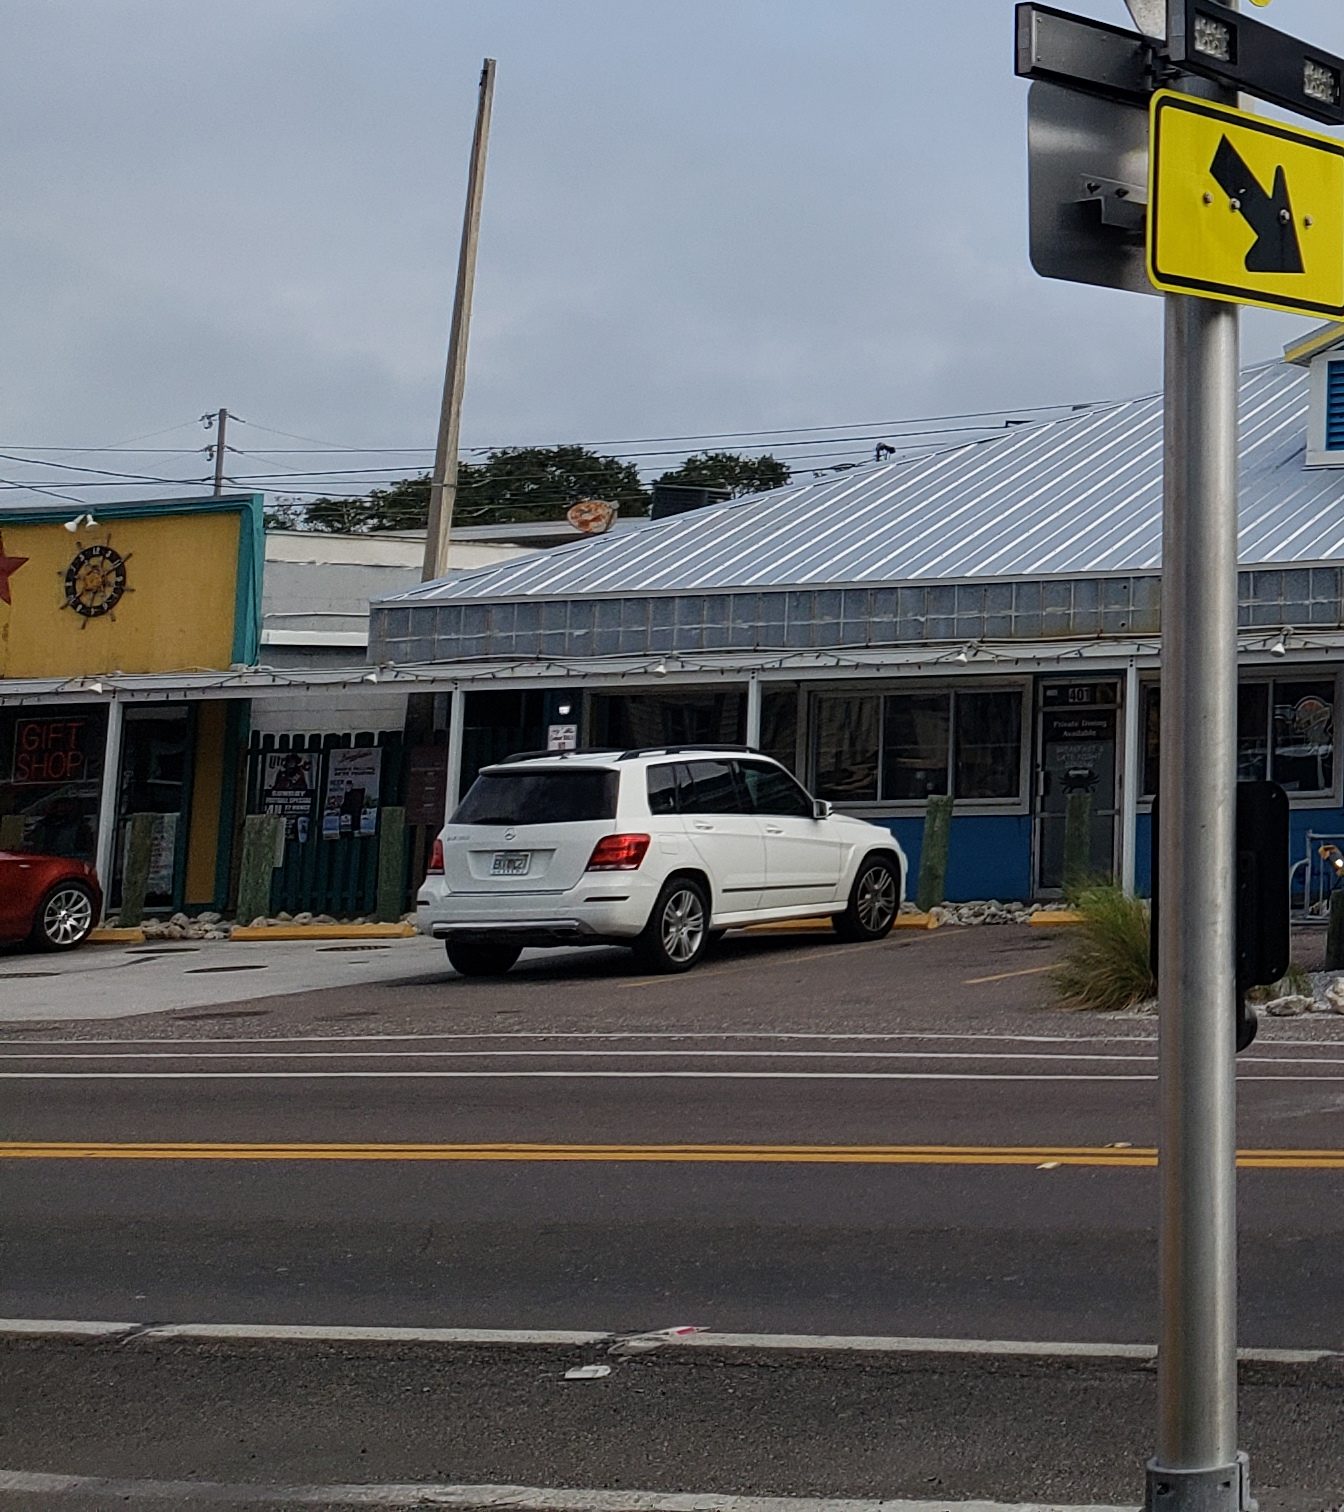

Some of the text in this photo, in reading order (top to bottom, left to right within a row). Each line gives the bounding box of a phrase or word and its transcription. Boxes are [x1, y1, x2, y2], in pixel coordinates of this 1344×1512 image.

[1068, 687, 1090, 702] 401
[1053, 719, 1107, 728] Private Dining
[23, 722, 85, 750] GIFT
[1063, 729, 1097, 737] Available
[17, 751, 84, 780] SHOP
